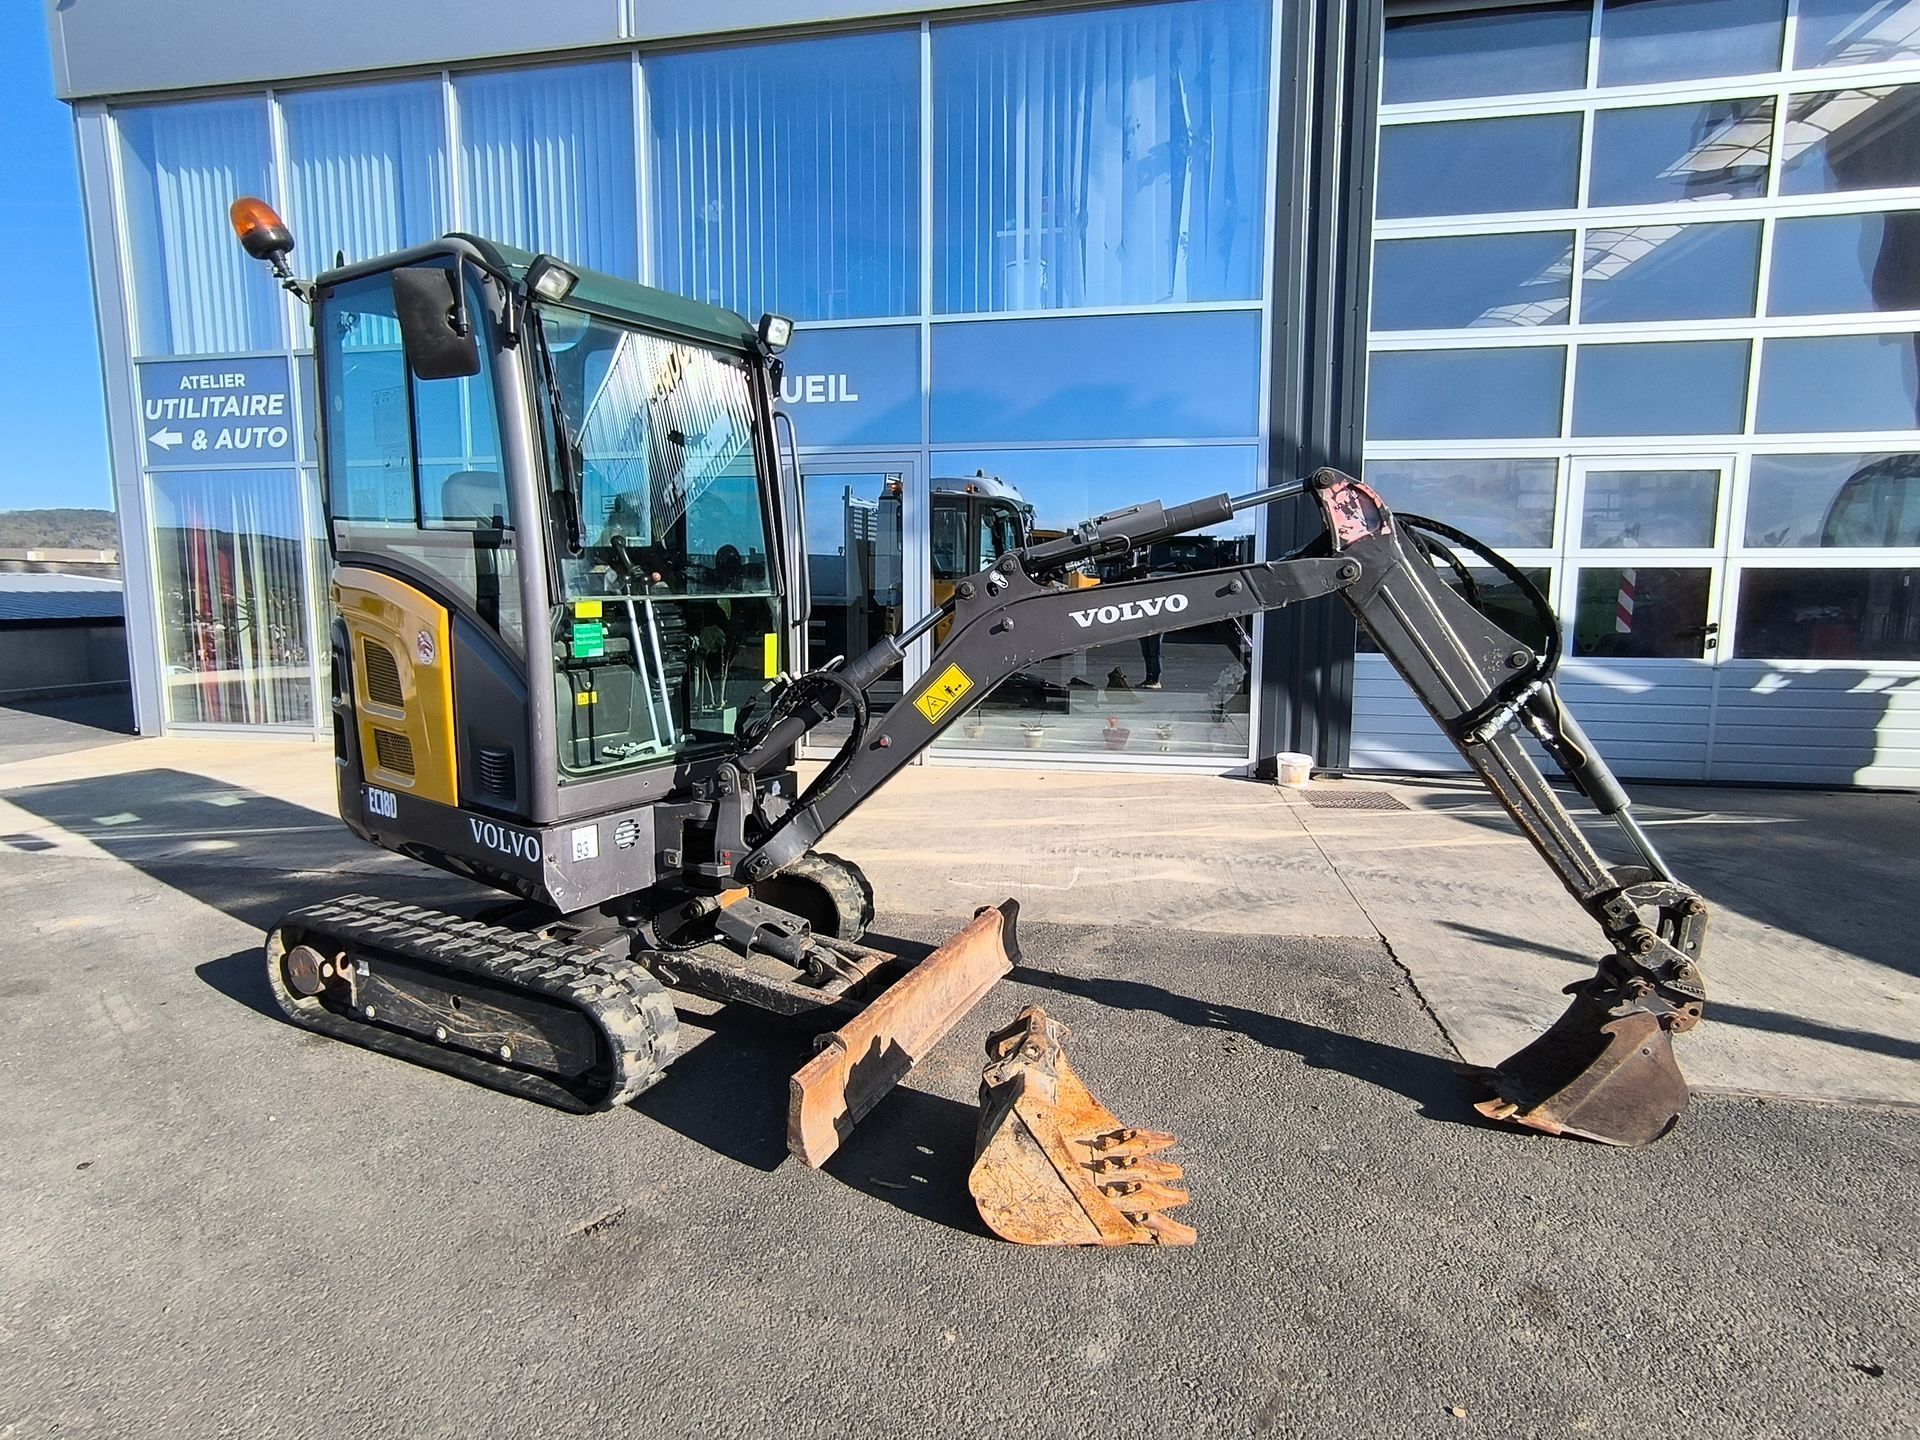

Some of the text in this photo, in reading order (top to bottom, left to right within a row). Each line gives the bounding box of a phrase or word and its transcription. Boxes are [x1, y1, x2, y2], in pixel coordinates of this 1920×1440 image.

[179, 373, 246, 390] ATELIER
[145, 393, 285, 420] UTILITAIRE
[191, 426, 288, 451] & AUTO
[1068, 593, 1189, 628] VOLVO
[368, 787, 398, 819] EC18D
[468, 817, 541, 863] VOLVO
